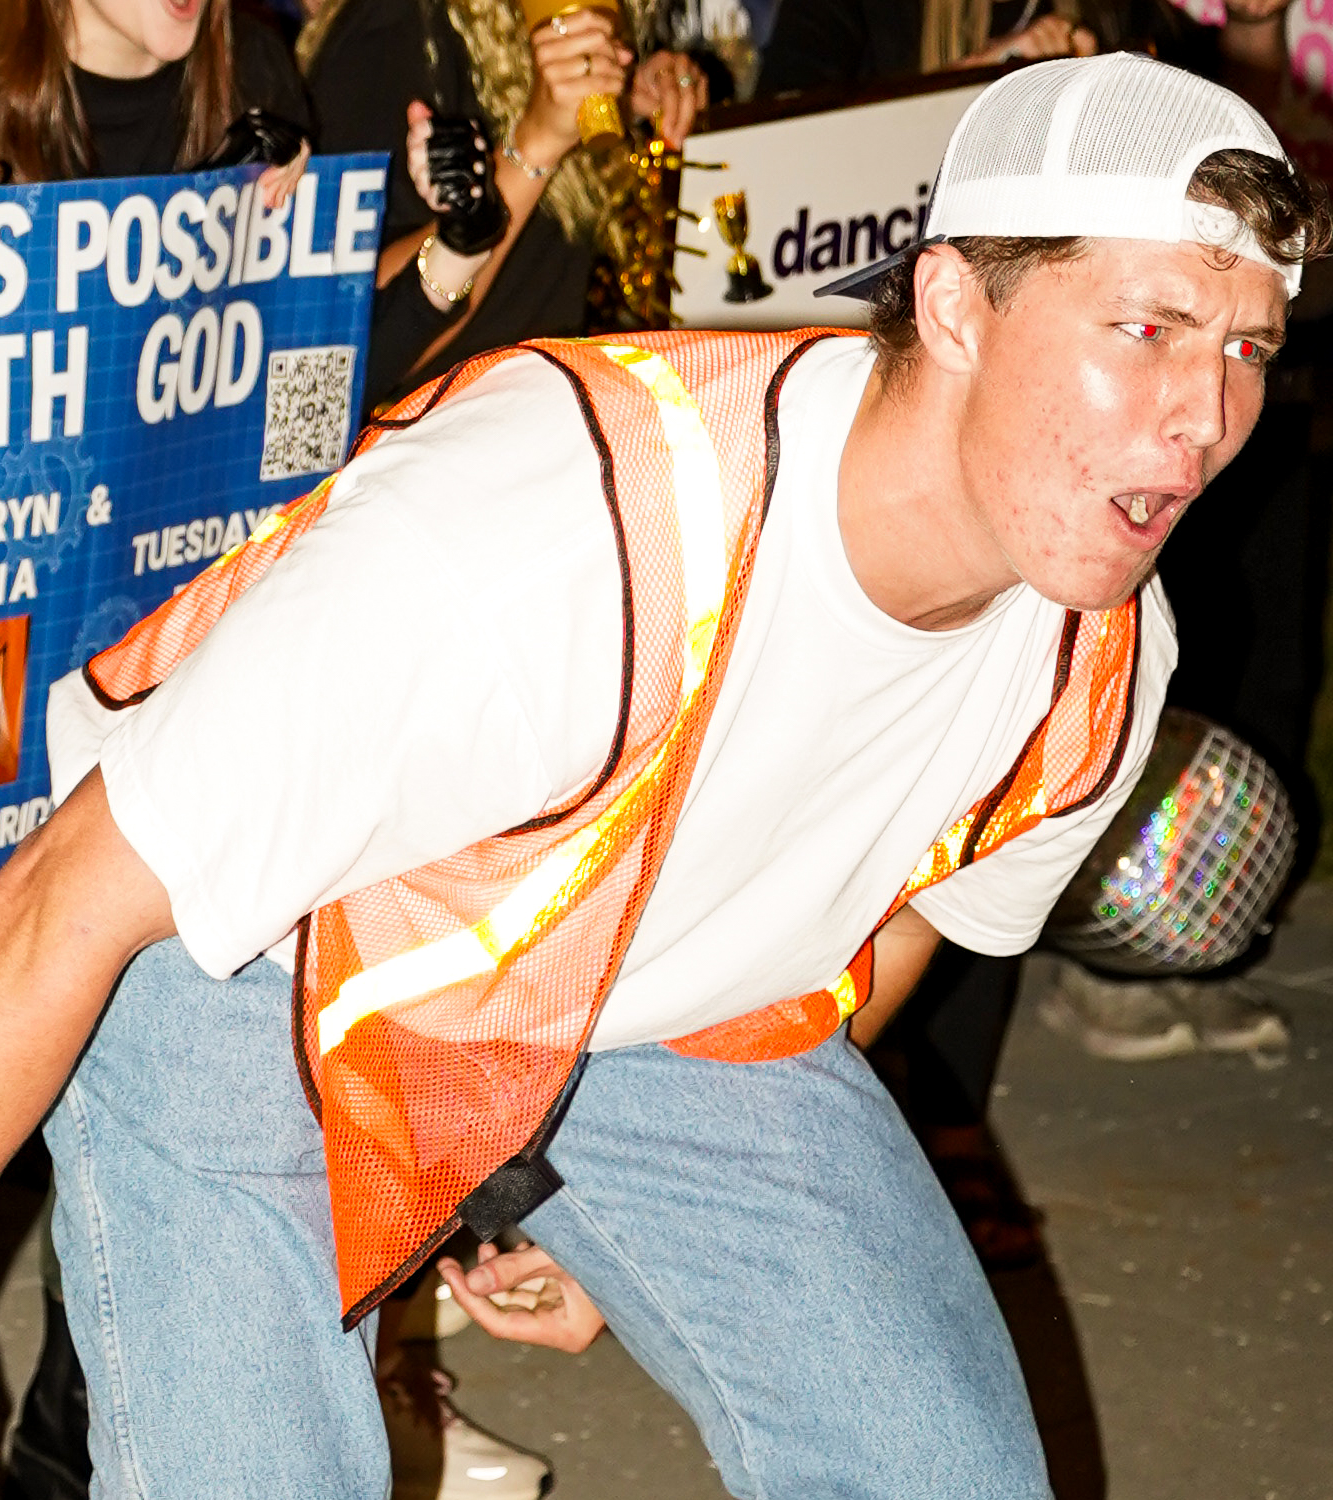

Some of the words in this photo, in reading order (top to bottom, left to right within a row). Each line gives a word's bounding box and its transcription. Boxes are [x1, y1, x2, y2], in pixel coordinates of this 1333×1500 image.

[56, 168, 386, 313] POSSIBLE
[137, 302, 264, 425] GOD
[85, 483, 113, 530] &
